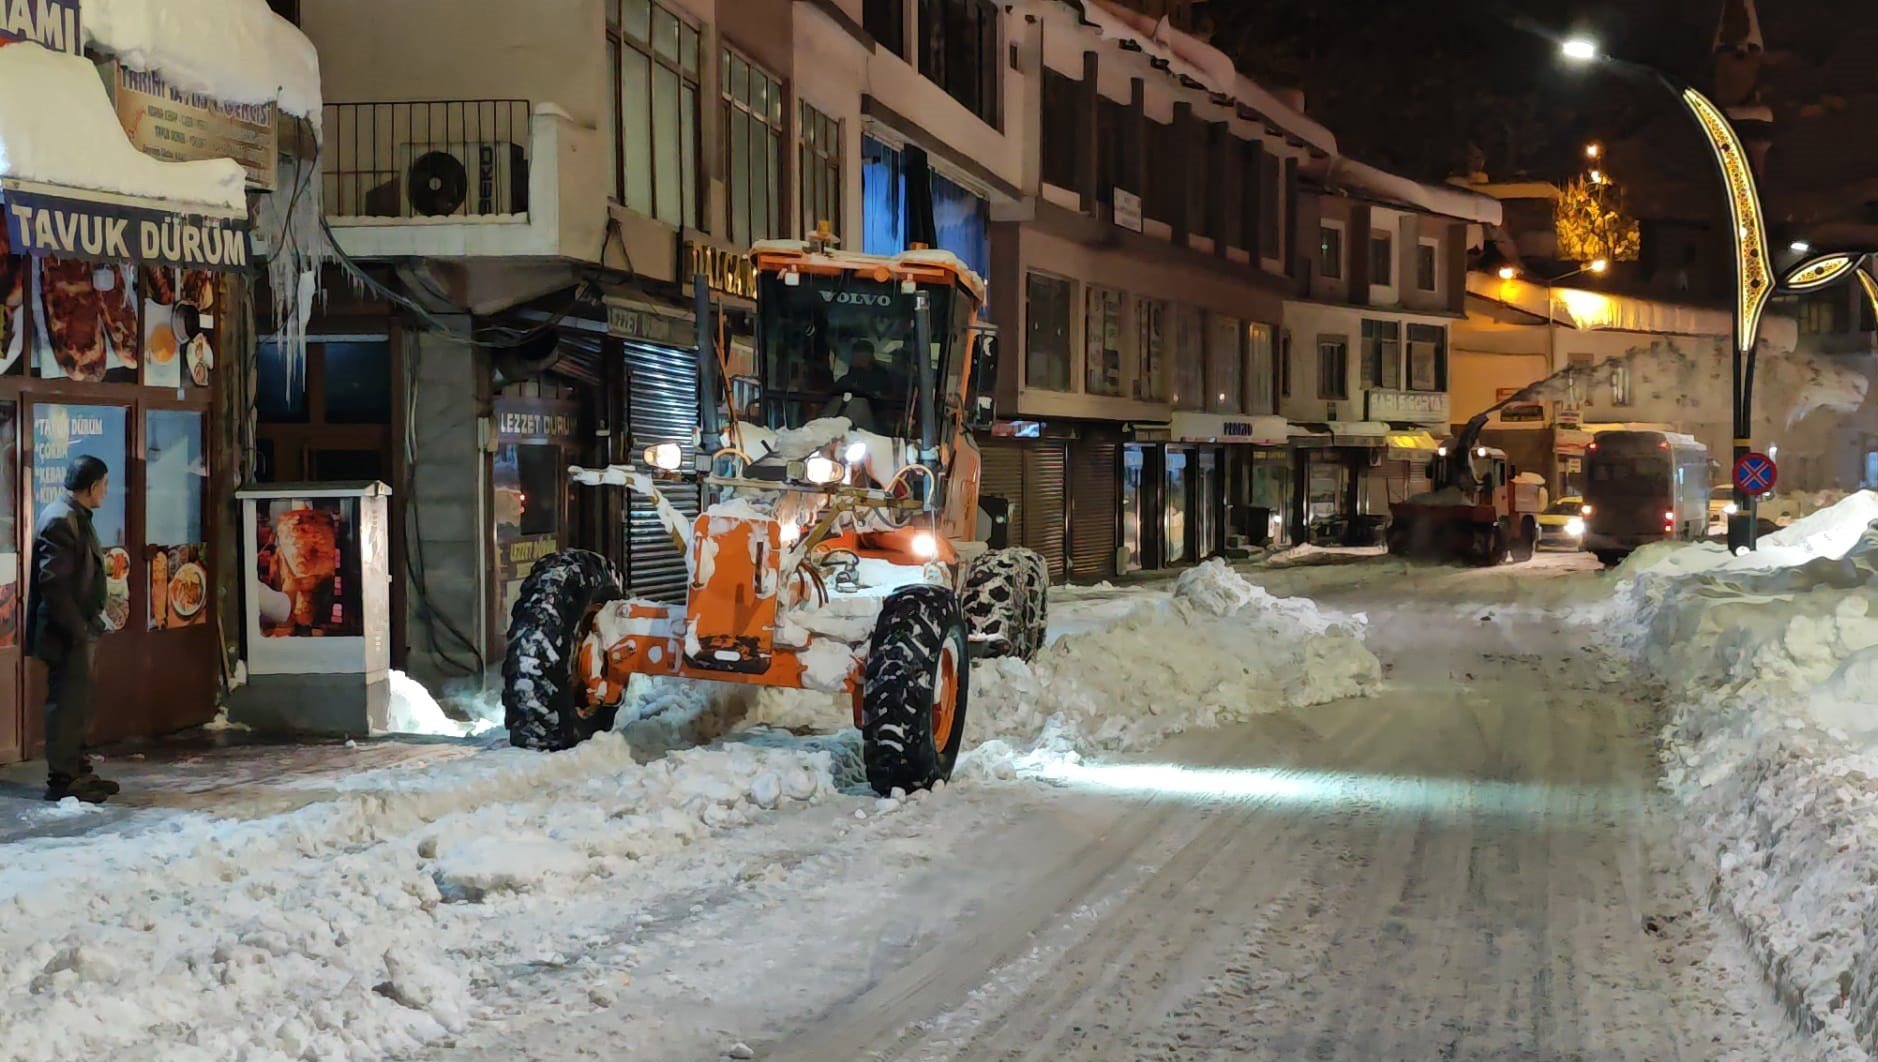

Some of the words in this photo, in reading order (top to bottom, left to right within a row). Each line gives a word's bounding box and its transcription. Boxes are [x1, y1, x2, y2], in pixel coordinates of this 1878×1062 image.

[12, 203, 130, 259] TAVUK
[140, 212, 246, 267] DÜRÜM
[817, 290, 892, 307] VOLVO
[501, 412, 541, 434] LEZZET
